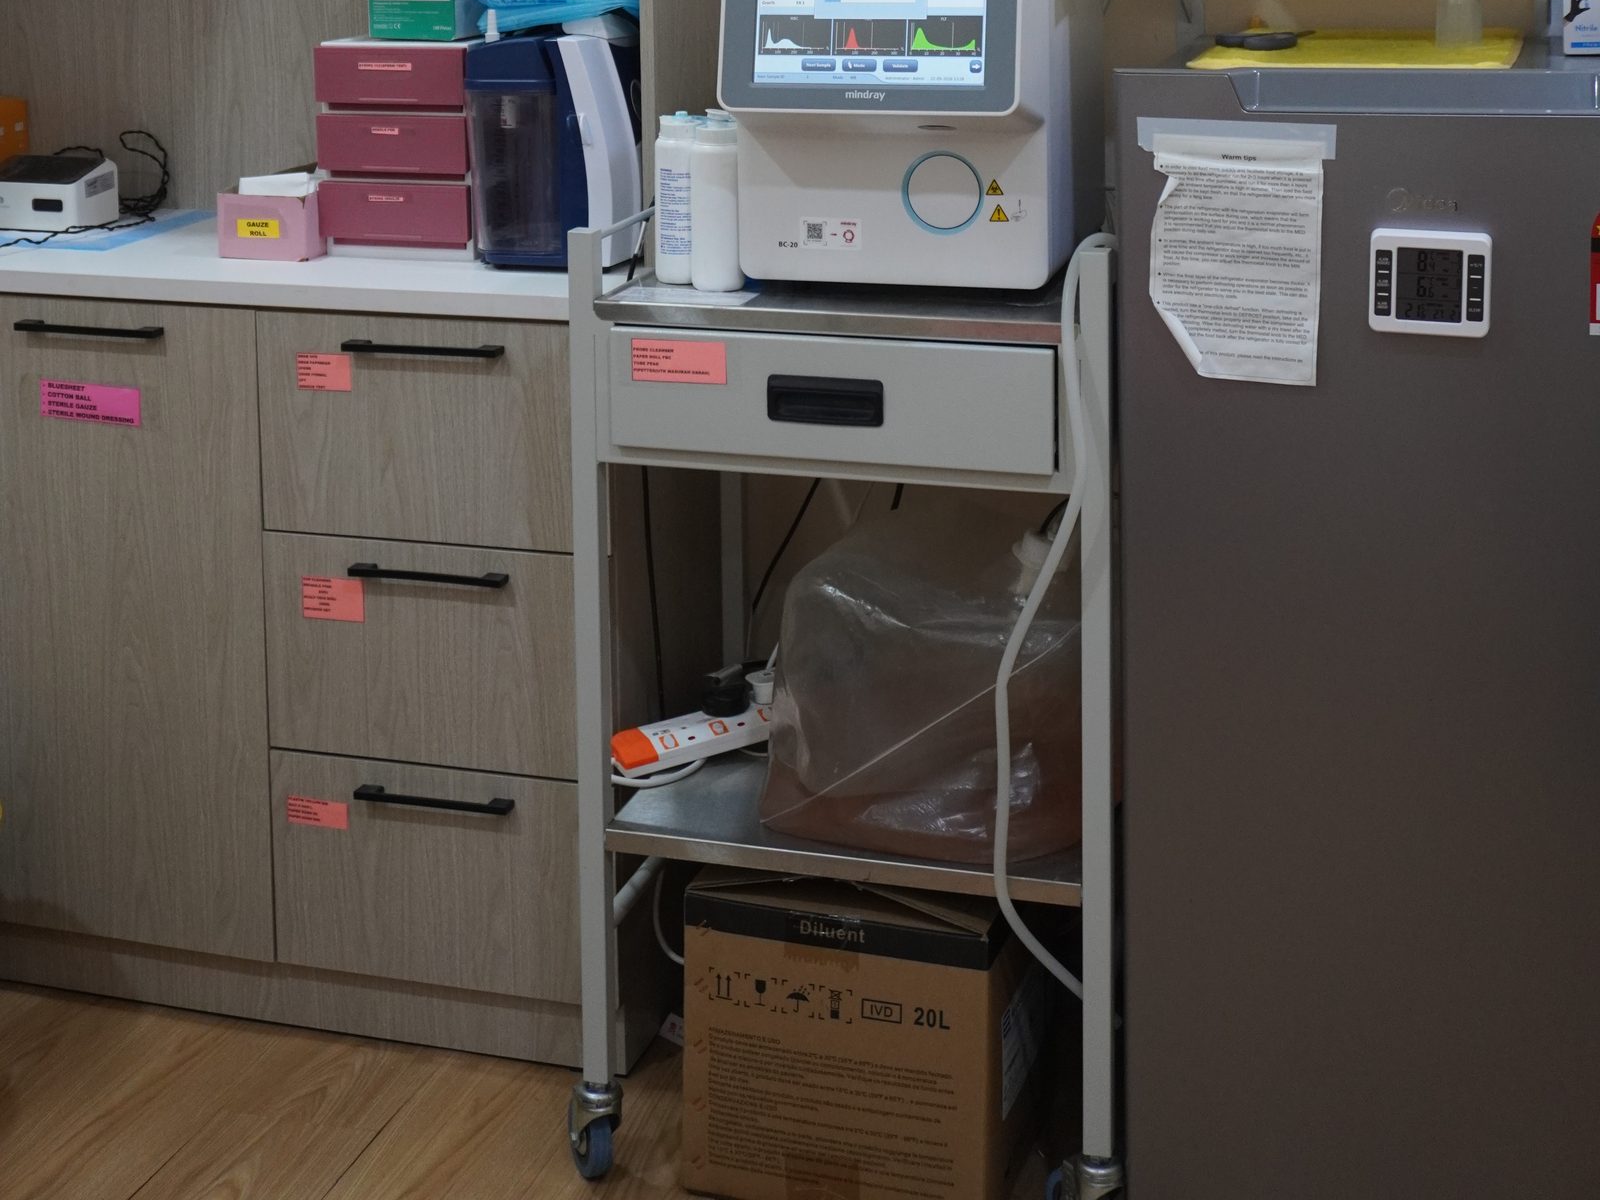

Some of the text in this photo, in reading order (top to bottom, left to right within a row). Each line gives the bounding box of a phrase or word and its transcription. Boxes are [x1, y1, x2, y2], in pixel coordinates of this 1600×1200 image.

[845, 89, 885, 101] mindray
[48, 382, 85, 391] BLUESHEET
[48, 409, 134, 424] STERILE WOUND DRESSING
[800, 920, 866, 944] Diluent
[870, 1004, 893, 1018] IVD
[913, 1007, 950, 1030] 20L
